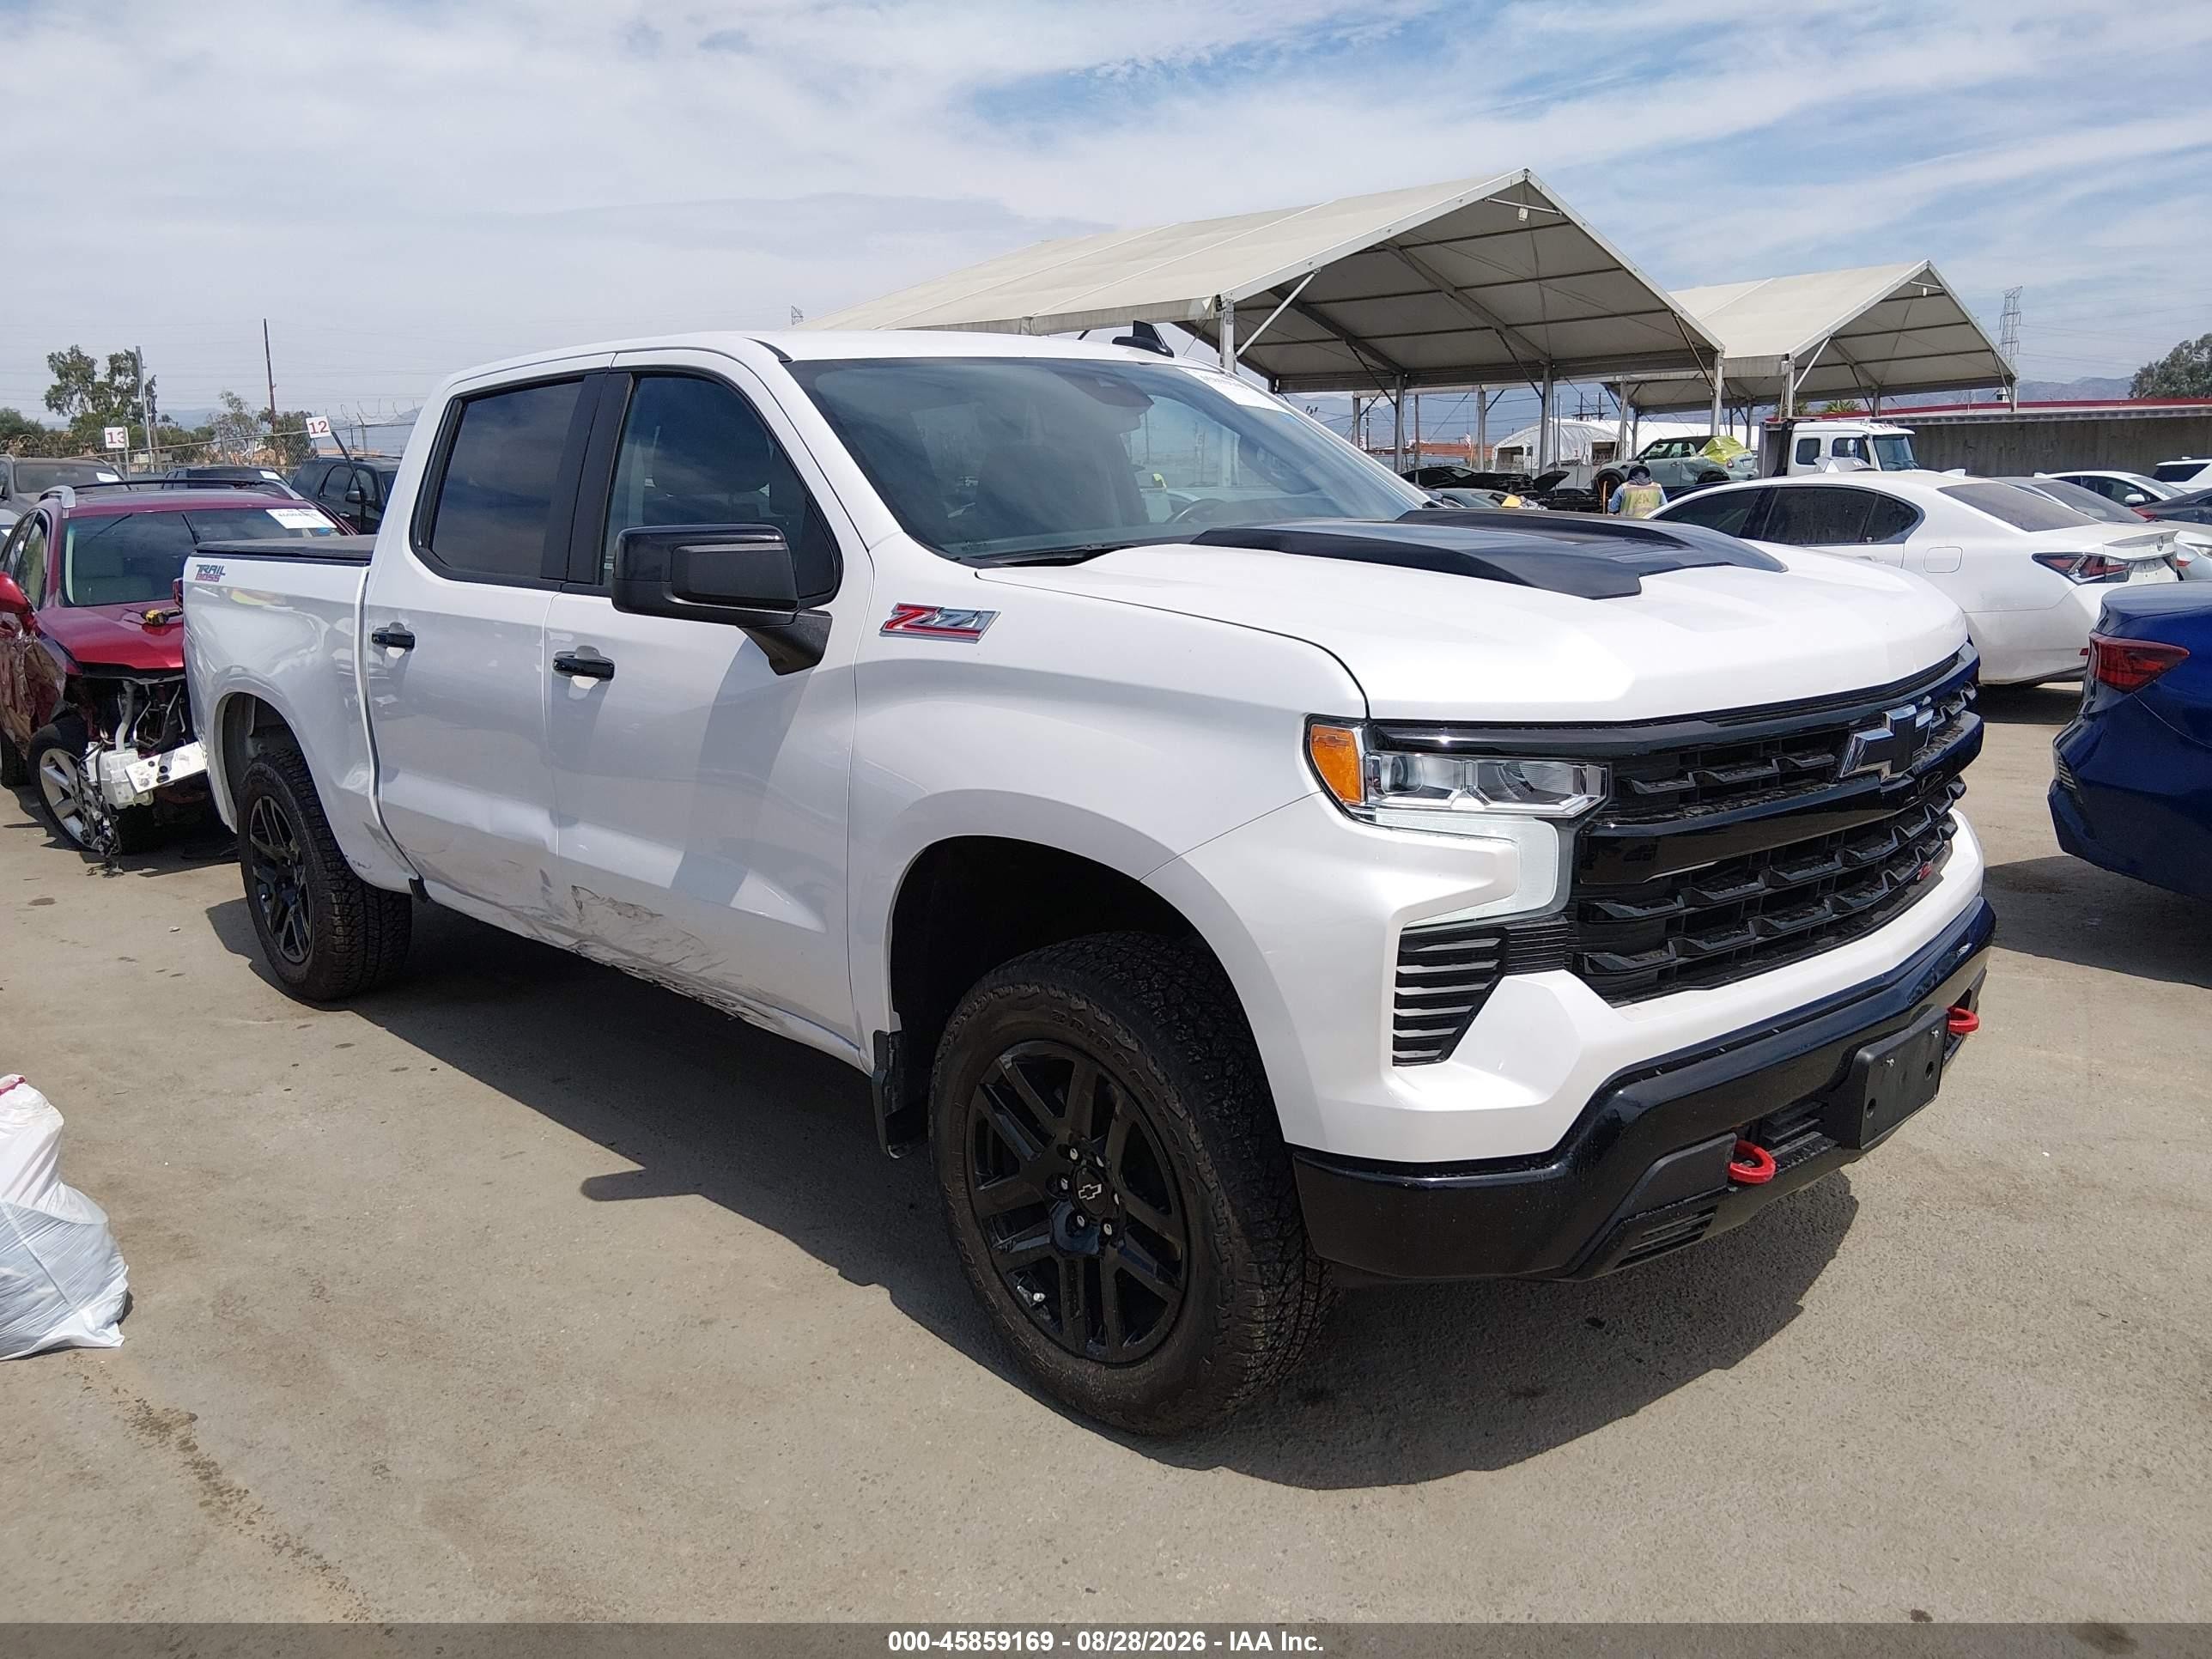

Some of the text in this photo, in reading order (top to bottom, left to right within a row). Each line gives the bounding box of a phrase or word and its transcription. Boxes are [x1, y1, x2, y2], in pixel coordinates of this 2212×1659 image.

[308, 419, 330, 435] 12
[106, 431, 125, 445] 13
[196, 564, 226, 577] TRAIL
